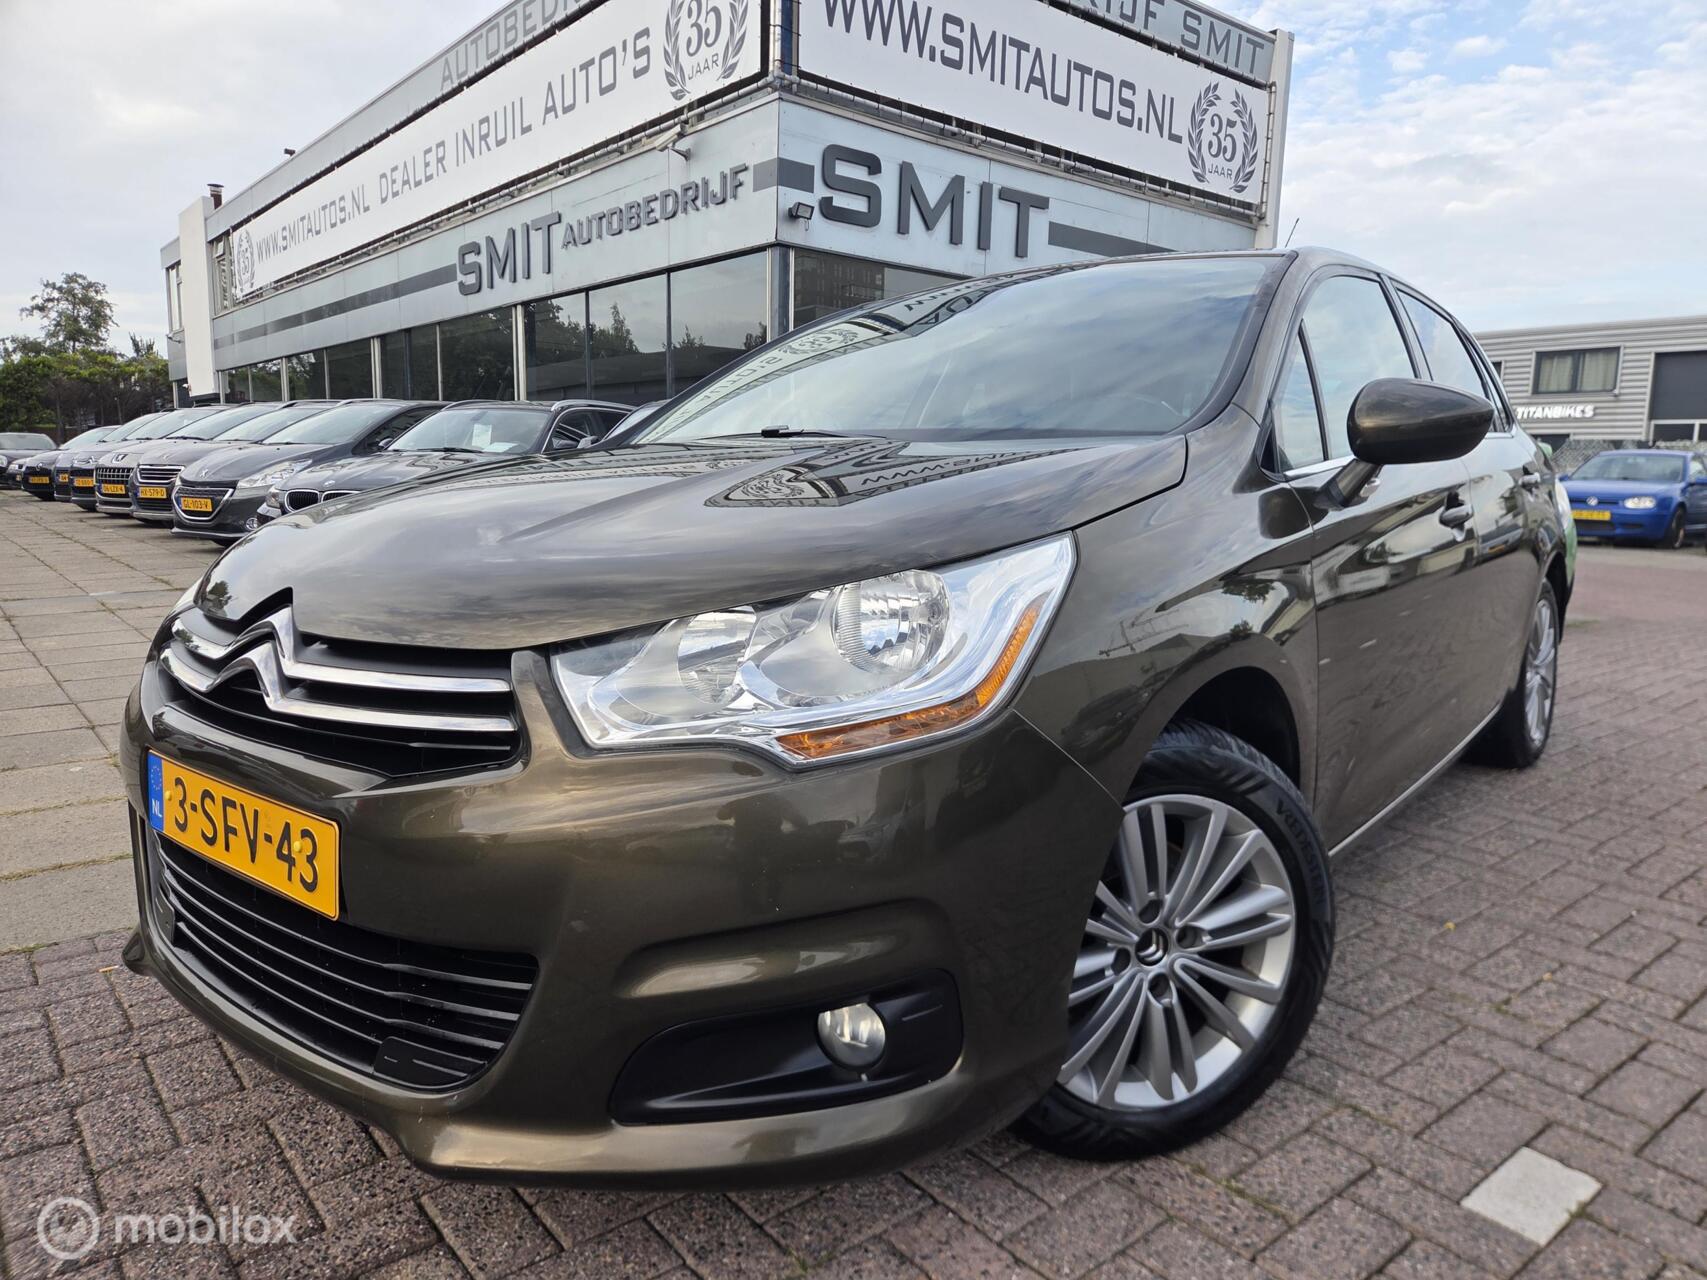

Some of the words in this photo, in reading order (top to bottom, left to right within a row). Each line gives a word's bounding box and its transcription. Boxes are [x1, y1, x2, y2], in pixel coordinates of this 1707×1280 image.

[440, 0, 582, 91] AUTOBED
[685, 0, 722, 57] 35
[1180, 9, 1265, 74] SMIT
[687, 52, 720, 81] JAAR
[256, 183, 371, 264] WWW.SMITAUTOS.NL
[379, 139, 448, 205] DEALER
[455, 96, 533, 168] INRUIL
[542, 26, 651, 126] AUTO'S
[1208, 113, 1237, 163] 35
[820, 143, 1050, 258] SMIT
[1208, 163, 1233, 180] JAAR
[457, 210, 562, 296] SMIT
[560, 162, 749, 250] AUTOBEDRIJF
[1516, 404, 1595, 419] TITANBIKES
[151, 798, 163, 818] NL
[174, 776, 319, 893] 3-SFV-43
